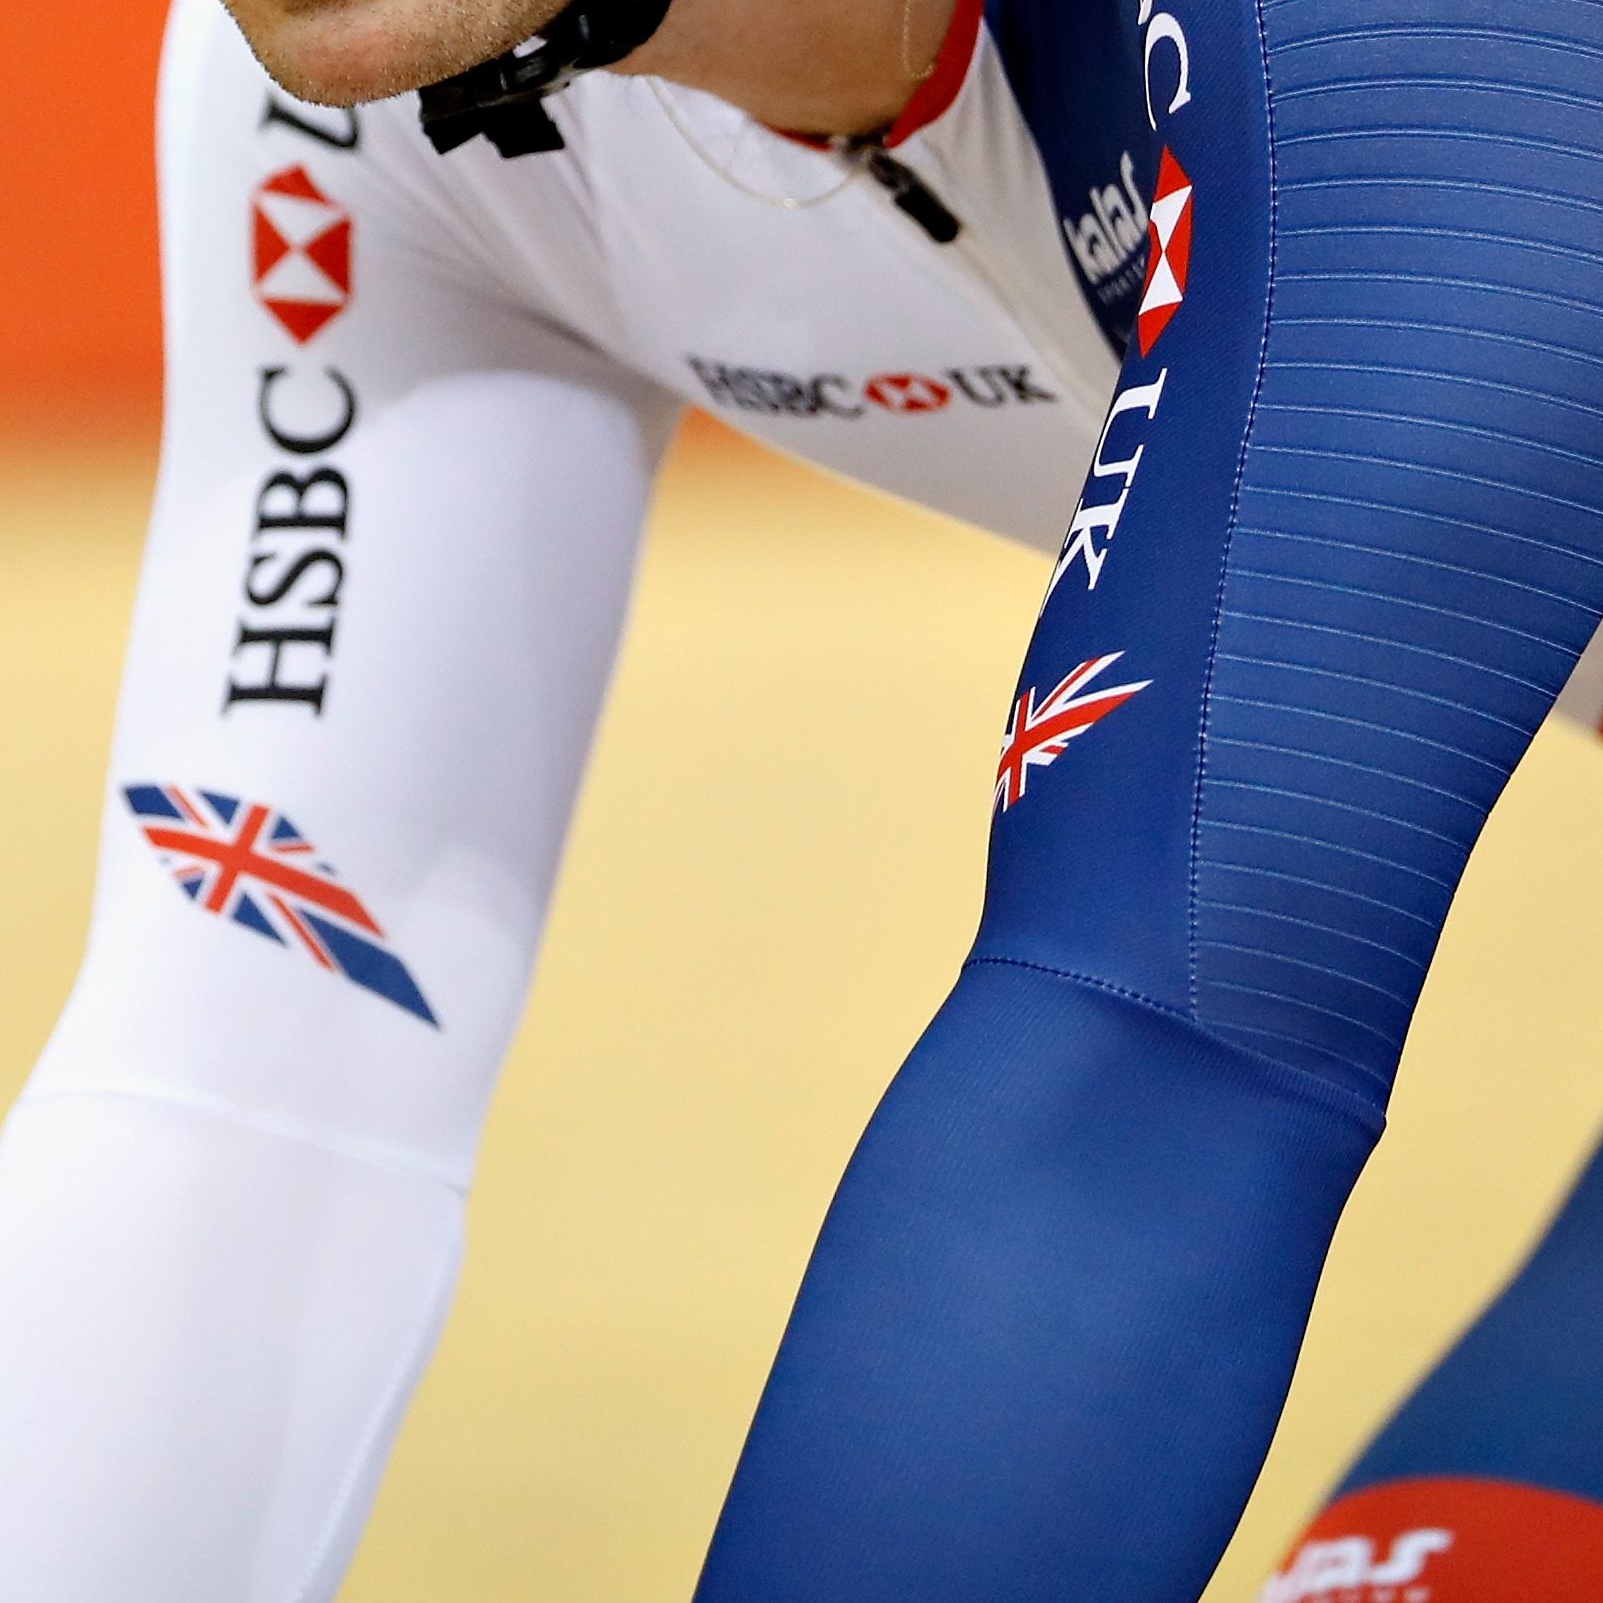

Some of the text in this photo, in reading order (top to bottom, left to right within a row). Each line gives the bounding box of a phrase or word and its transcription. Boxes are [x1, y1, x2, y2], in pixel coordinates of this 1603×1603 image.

[685, 353, 1058, 422] HSBC UK
[1039, 367, 1168, 618] UK
[221, 364, 358, 720] HSBC
